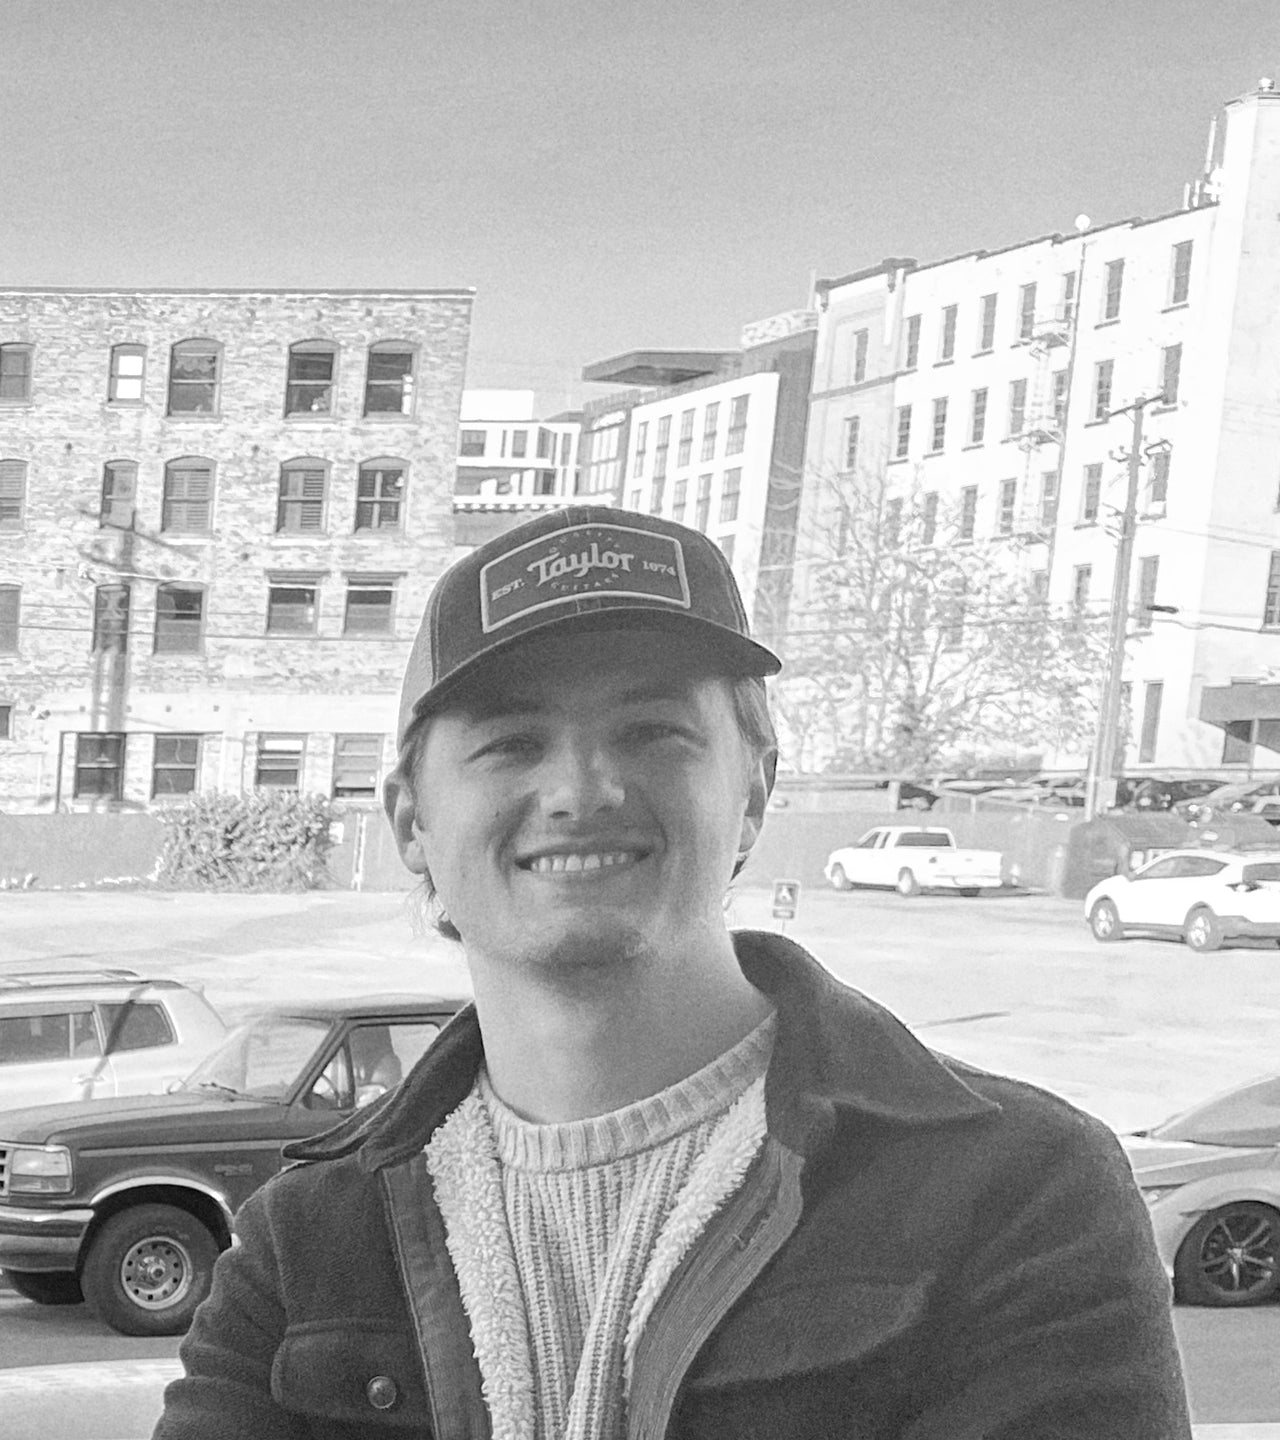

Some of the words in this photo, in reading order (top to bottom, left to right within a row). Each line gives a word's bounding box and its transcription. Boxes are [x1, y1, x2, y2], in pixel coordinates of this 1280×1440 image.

[491, 578, 526, 601] EST.
[526, 542, 635, 587] Taylor
[550, 572, 620, 592] GUITARS
